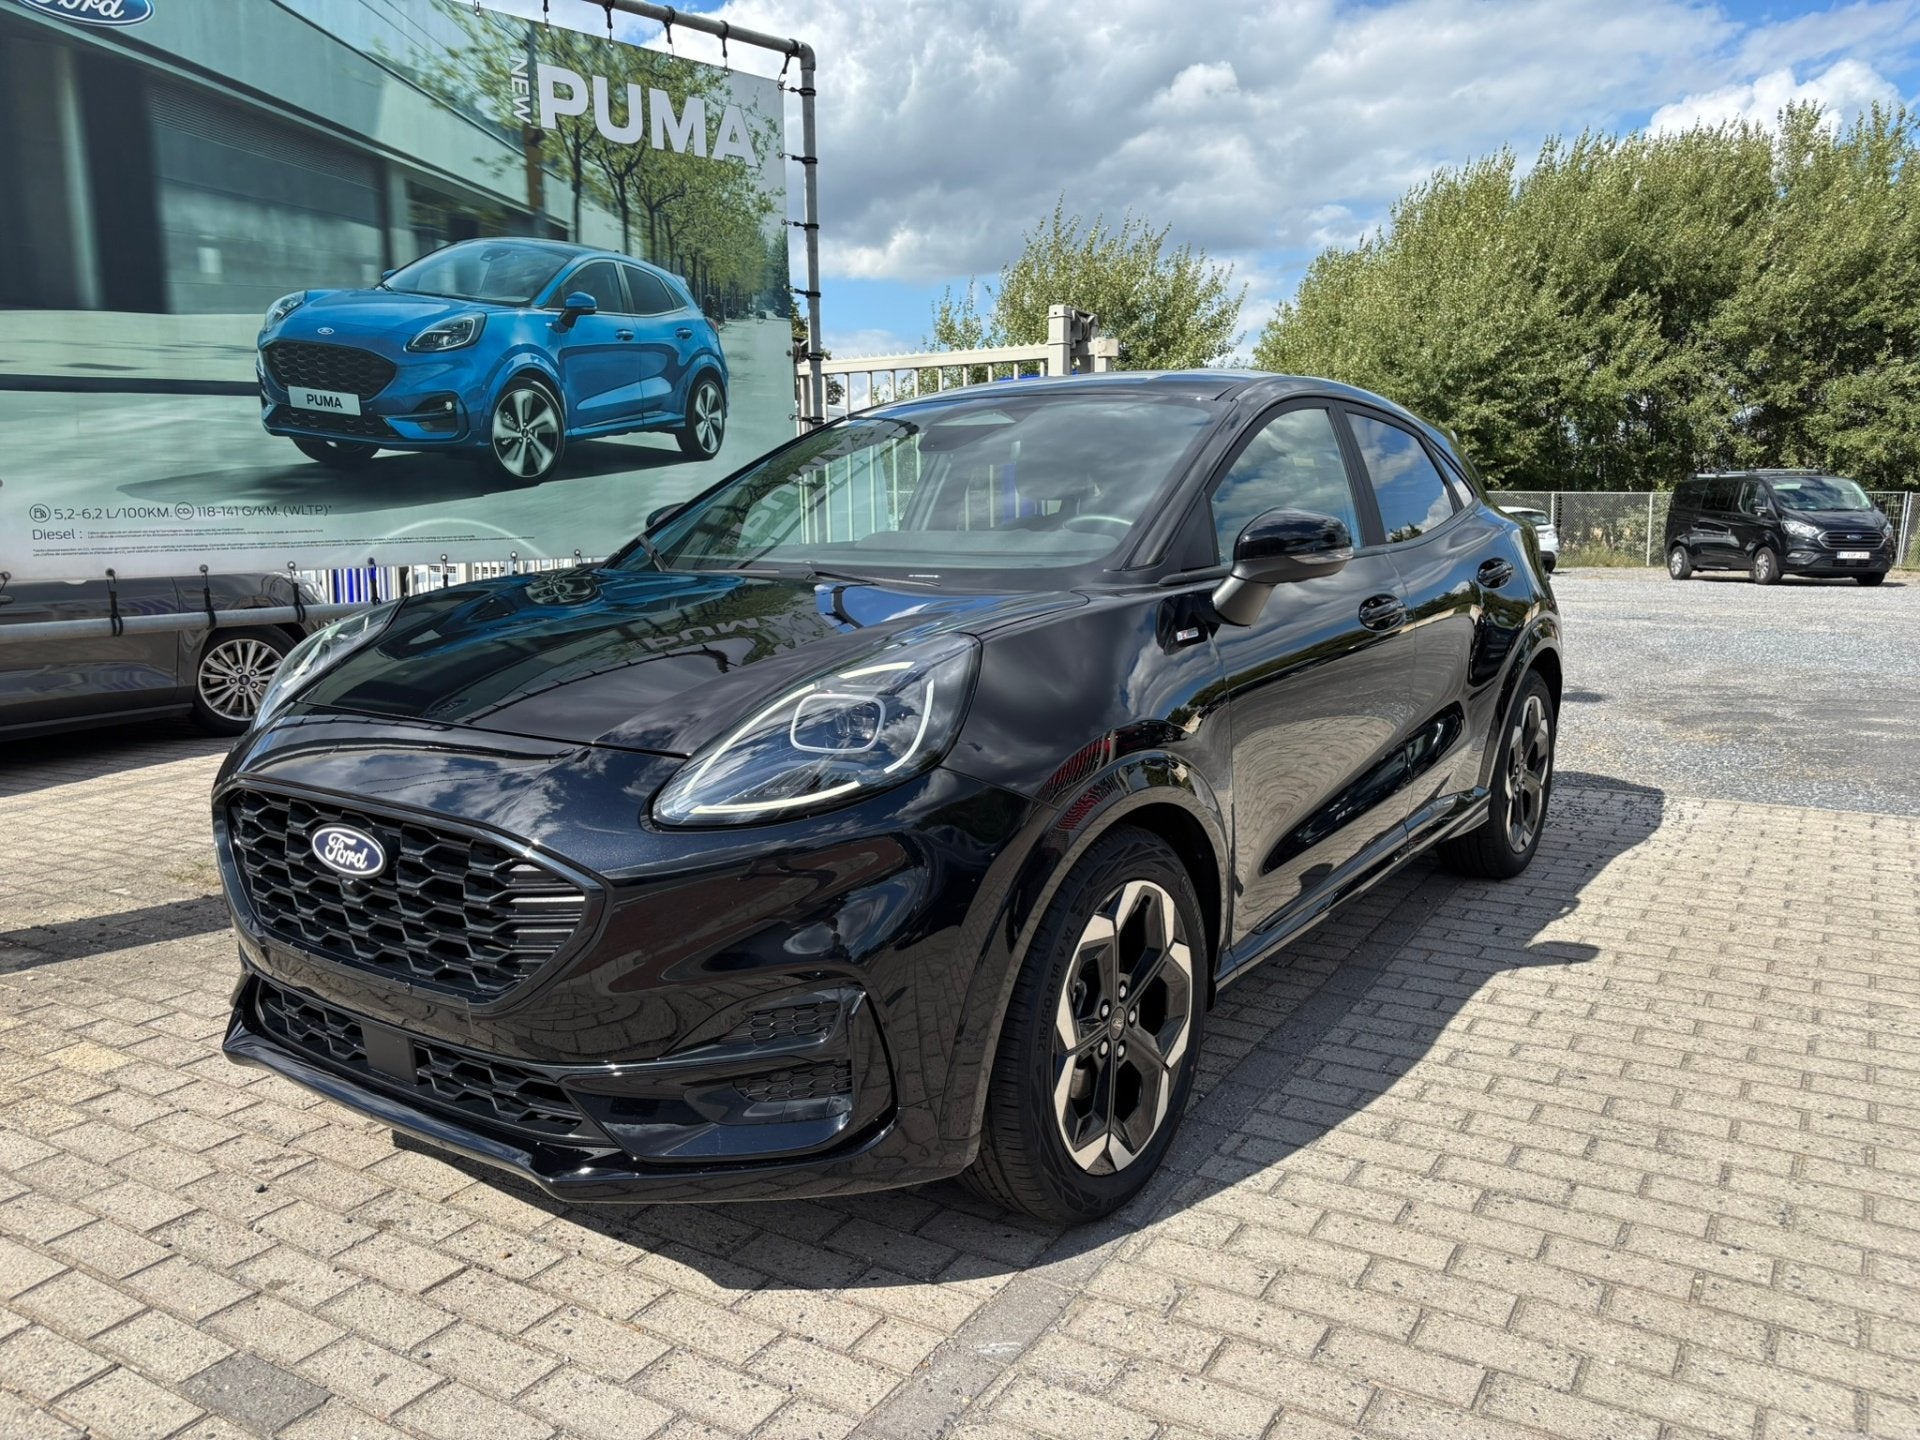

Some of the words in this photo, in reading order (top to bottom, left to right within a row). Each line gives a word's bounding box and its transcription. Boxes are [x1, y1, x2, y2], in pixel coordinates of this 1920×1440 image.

[509, 55, 532, 125] NEW
[537, 62, 758, 167] PUMA
[306, 393, 343, 409] PUMA
[54, 507, 103, 521] 5,2-6,2
[106, 506, 173, 519] L/100KM.
[197, 505, 239, 518] 118-141
[242, 505, 281, 517] G/KM.
[32, 528, 76, 540] Diesel
[325, 832, 368, 869] Ford
[1038, 997, 1053, 1051] 215/50
[1047, 982, 1057, 994] R
[1057, 945, 1066, 958] V
[1062, 926, 1076, 942] XL
